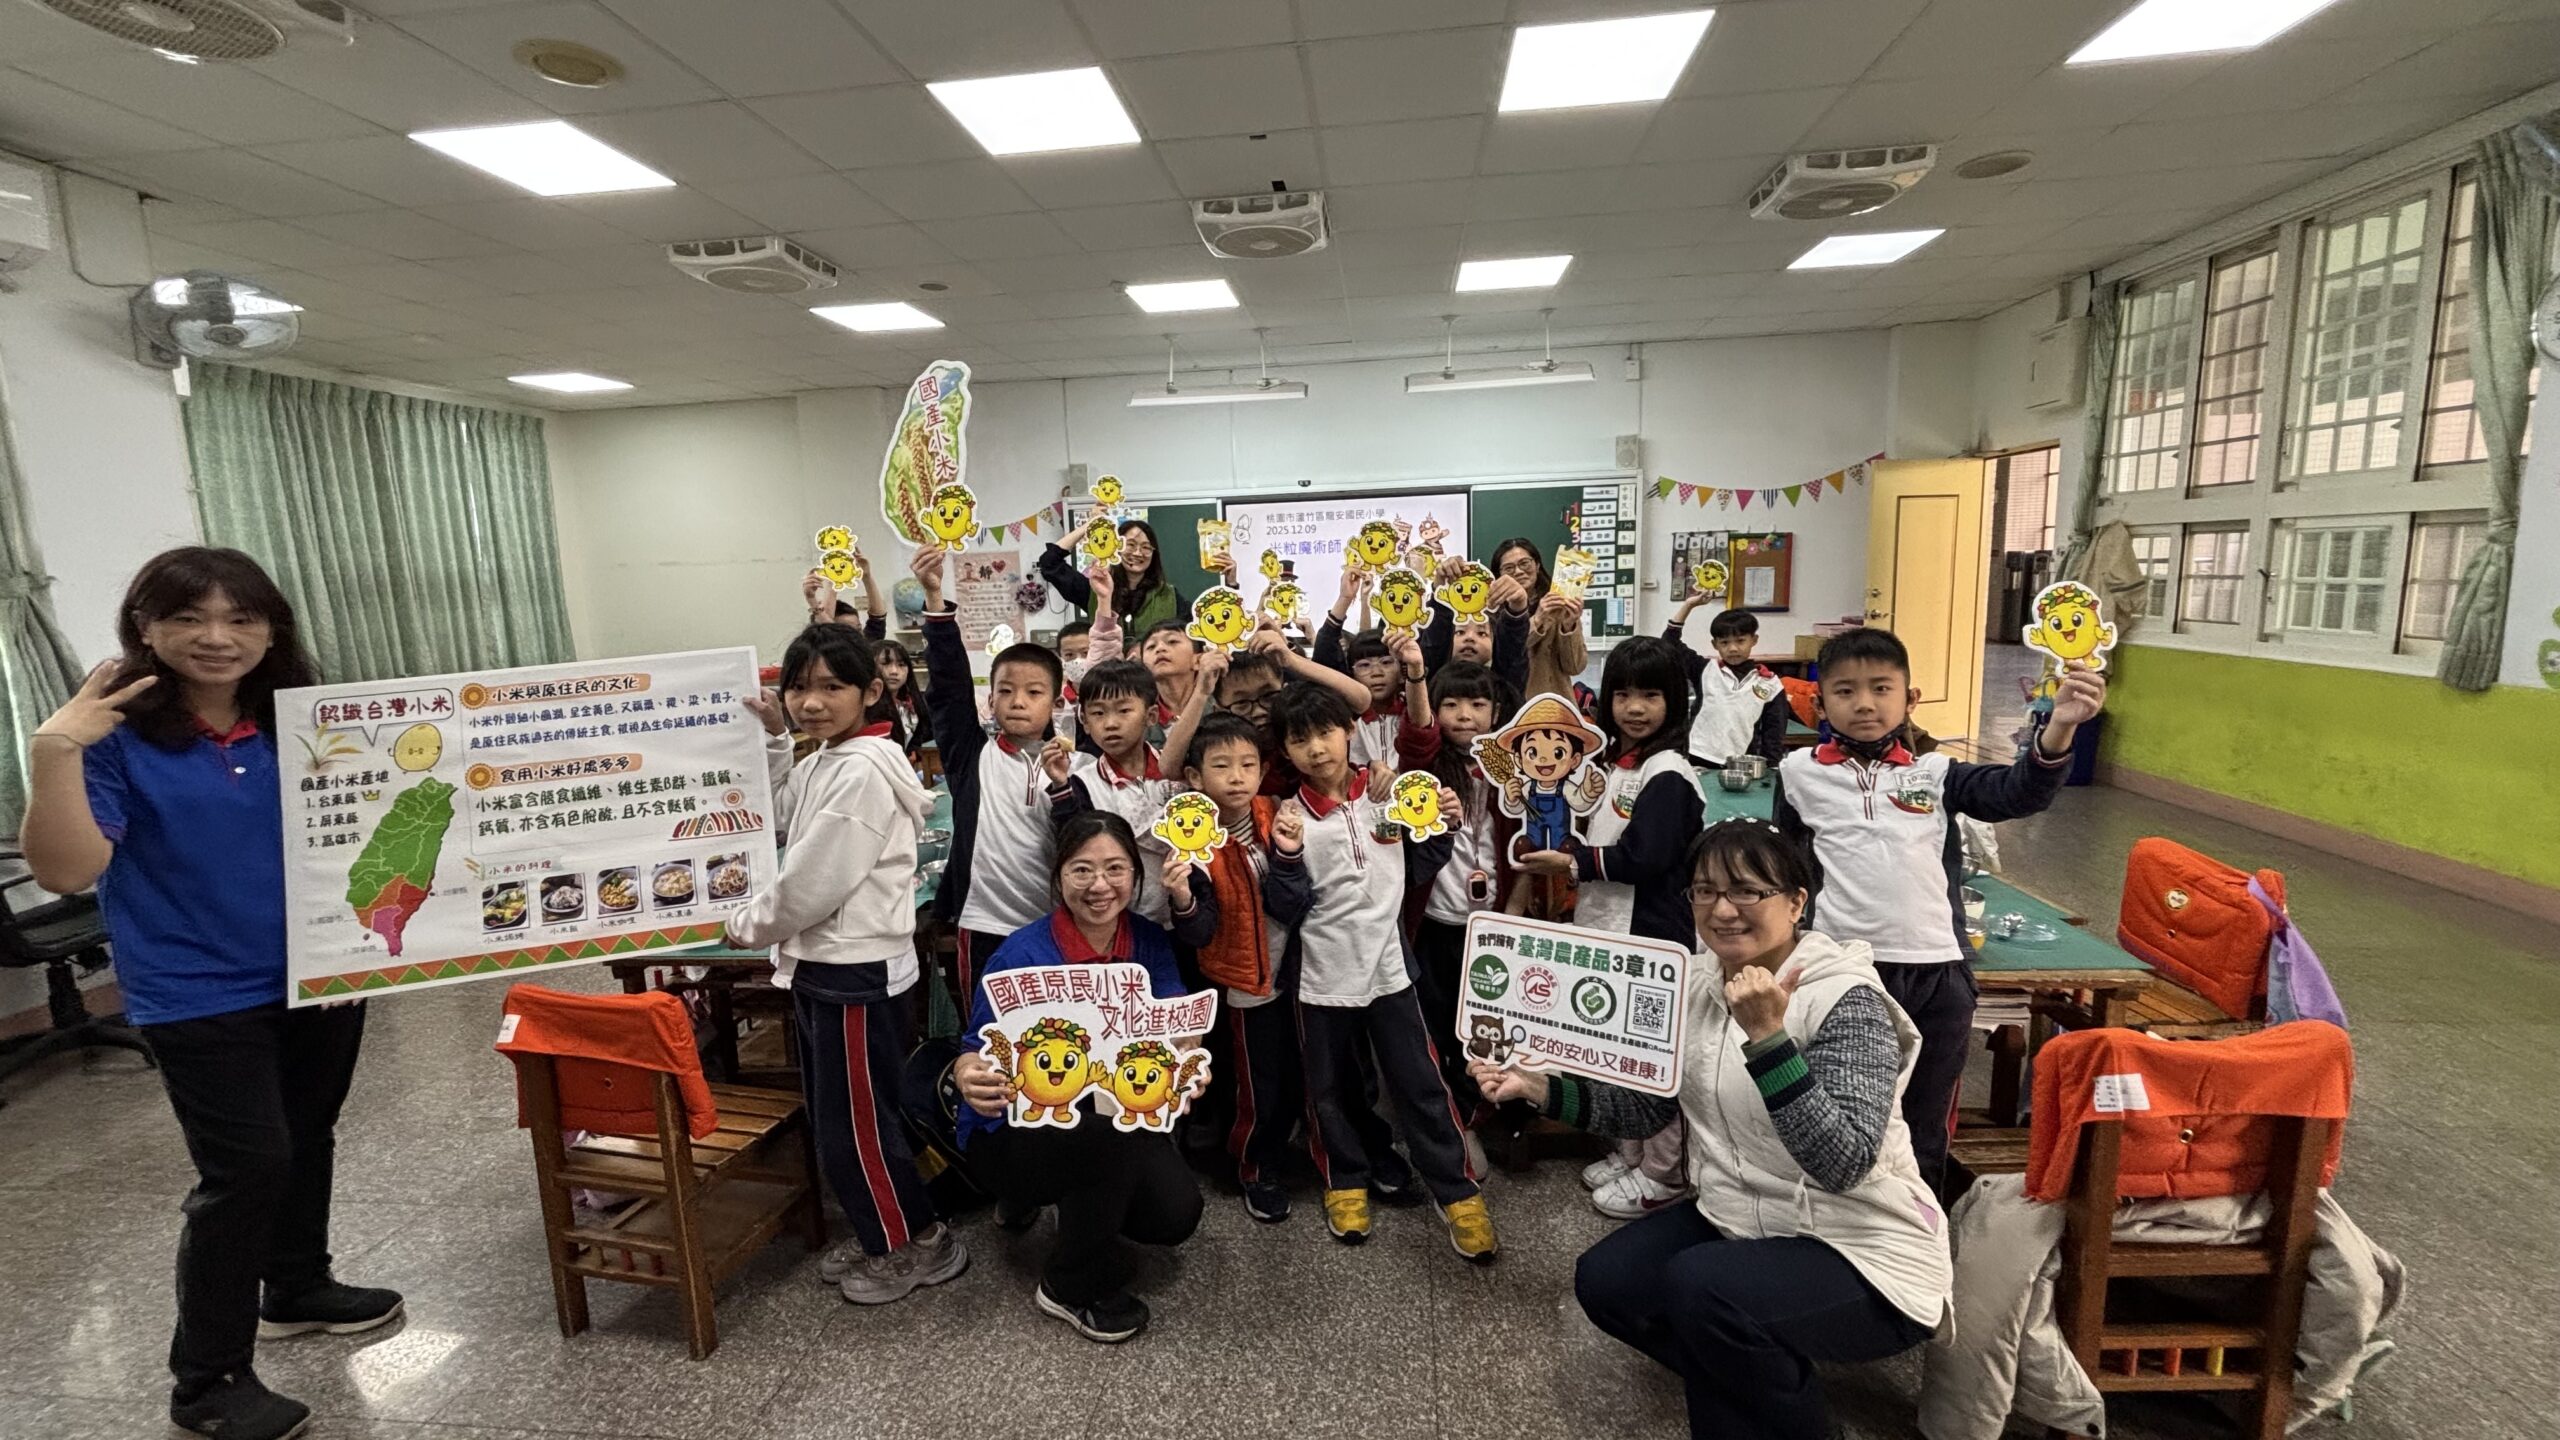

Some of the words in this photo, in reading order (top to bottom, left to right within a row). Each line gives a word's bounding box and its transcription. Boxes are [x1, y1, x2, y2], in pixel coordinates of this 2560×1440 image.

[919, 376, 957, 478] 國產小米
[1266, 508, 1385, 524] 桃園市蘆竹區龍安國民小學
[1270, 539, 1342, 556] 米粒魔術師
[492, 676, 637, 702] 小米與原住民的文化
[319, 694, 452, 723] 認識台灣小米
[500, 756, 630, 783] 食用小米好處多多
[301, 770, 390, 792] 國產小米產地
[319, 792, 358, 809] 台東縣
[320, 812, 359, 828] 屏東縣
[321, 832, 360, 847] 高雄市
[489, 860, 552, 876] 小米的料理
[1477, 933, 1516, 951] 我們擁有
[987, 968, 1147, 1015] 國產原民小米
[1098, 994, 1213, 1040] 文化進校園
[1529, 1034, 1666, 1082] 吃的安心又健康！
